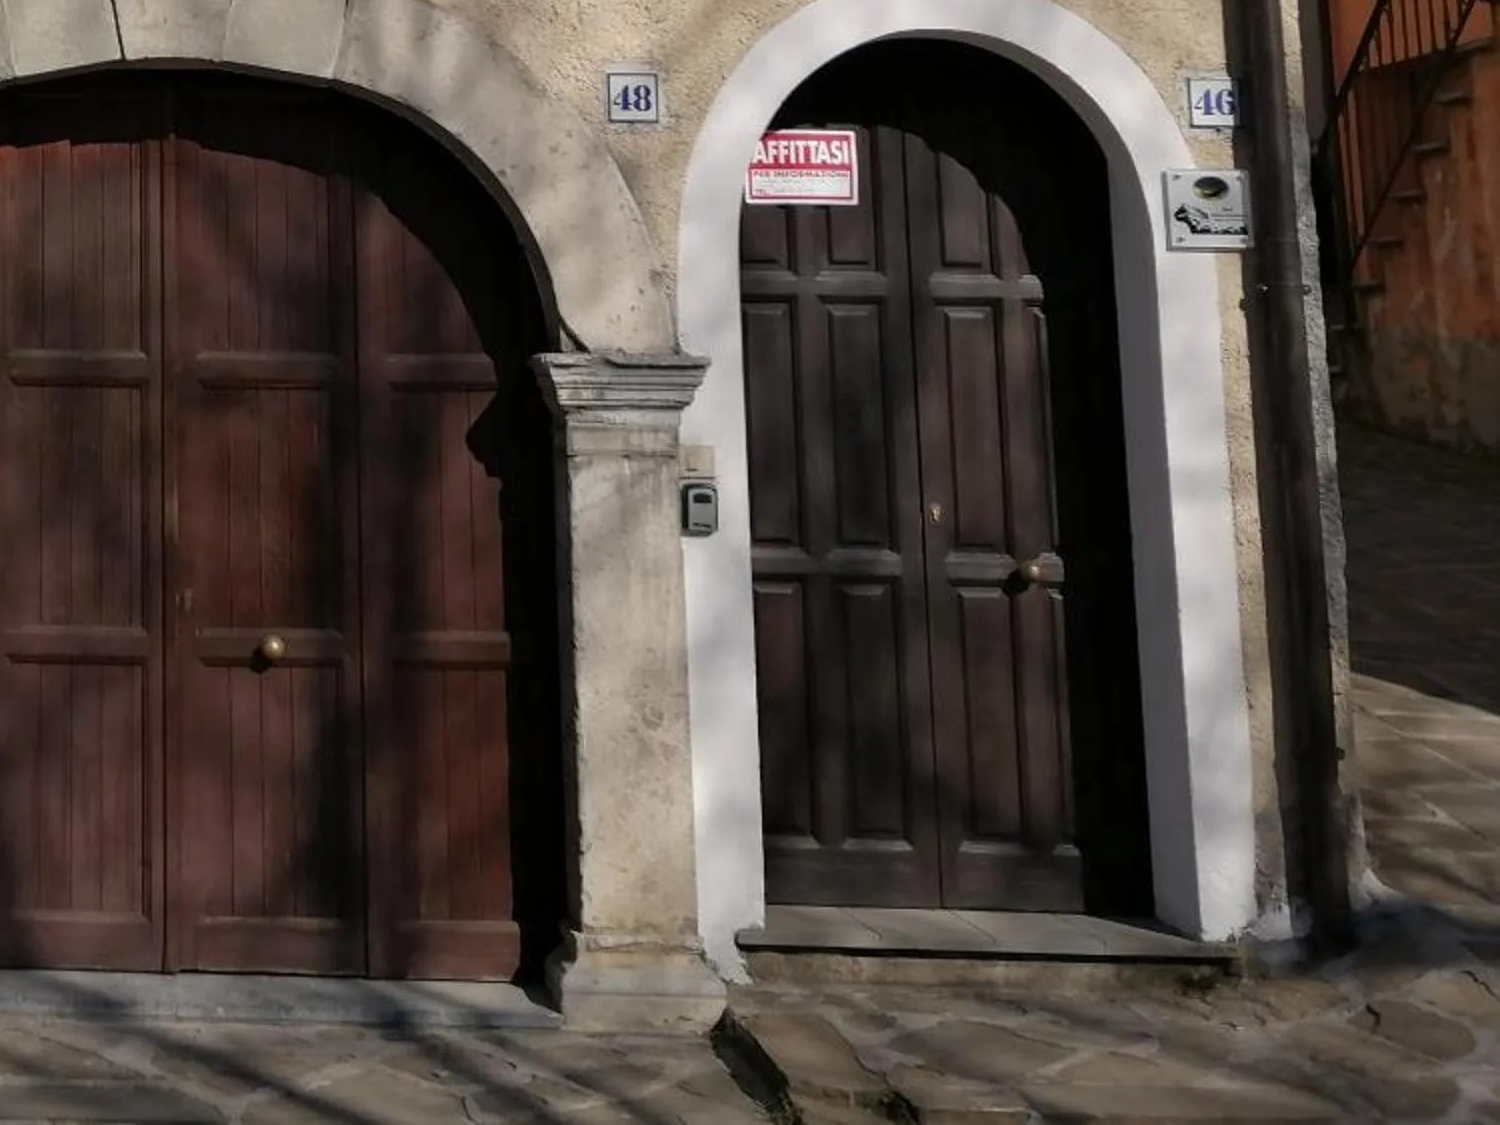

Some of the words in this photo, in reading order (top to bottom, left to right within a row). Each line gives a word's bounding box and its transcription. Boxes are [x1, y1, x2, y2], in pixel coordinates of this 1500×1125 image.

[612, 84, 652, 112] 48
[1193, 88, 1238, 116] 46
[752, 140, 850, 165] AFFITTASI
